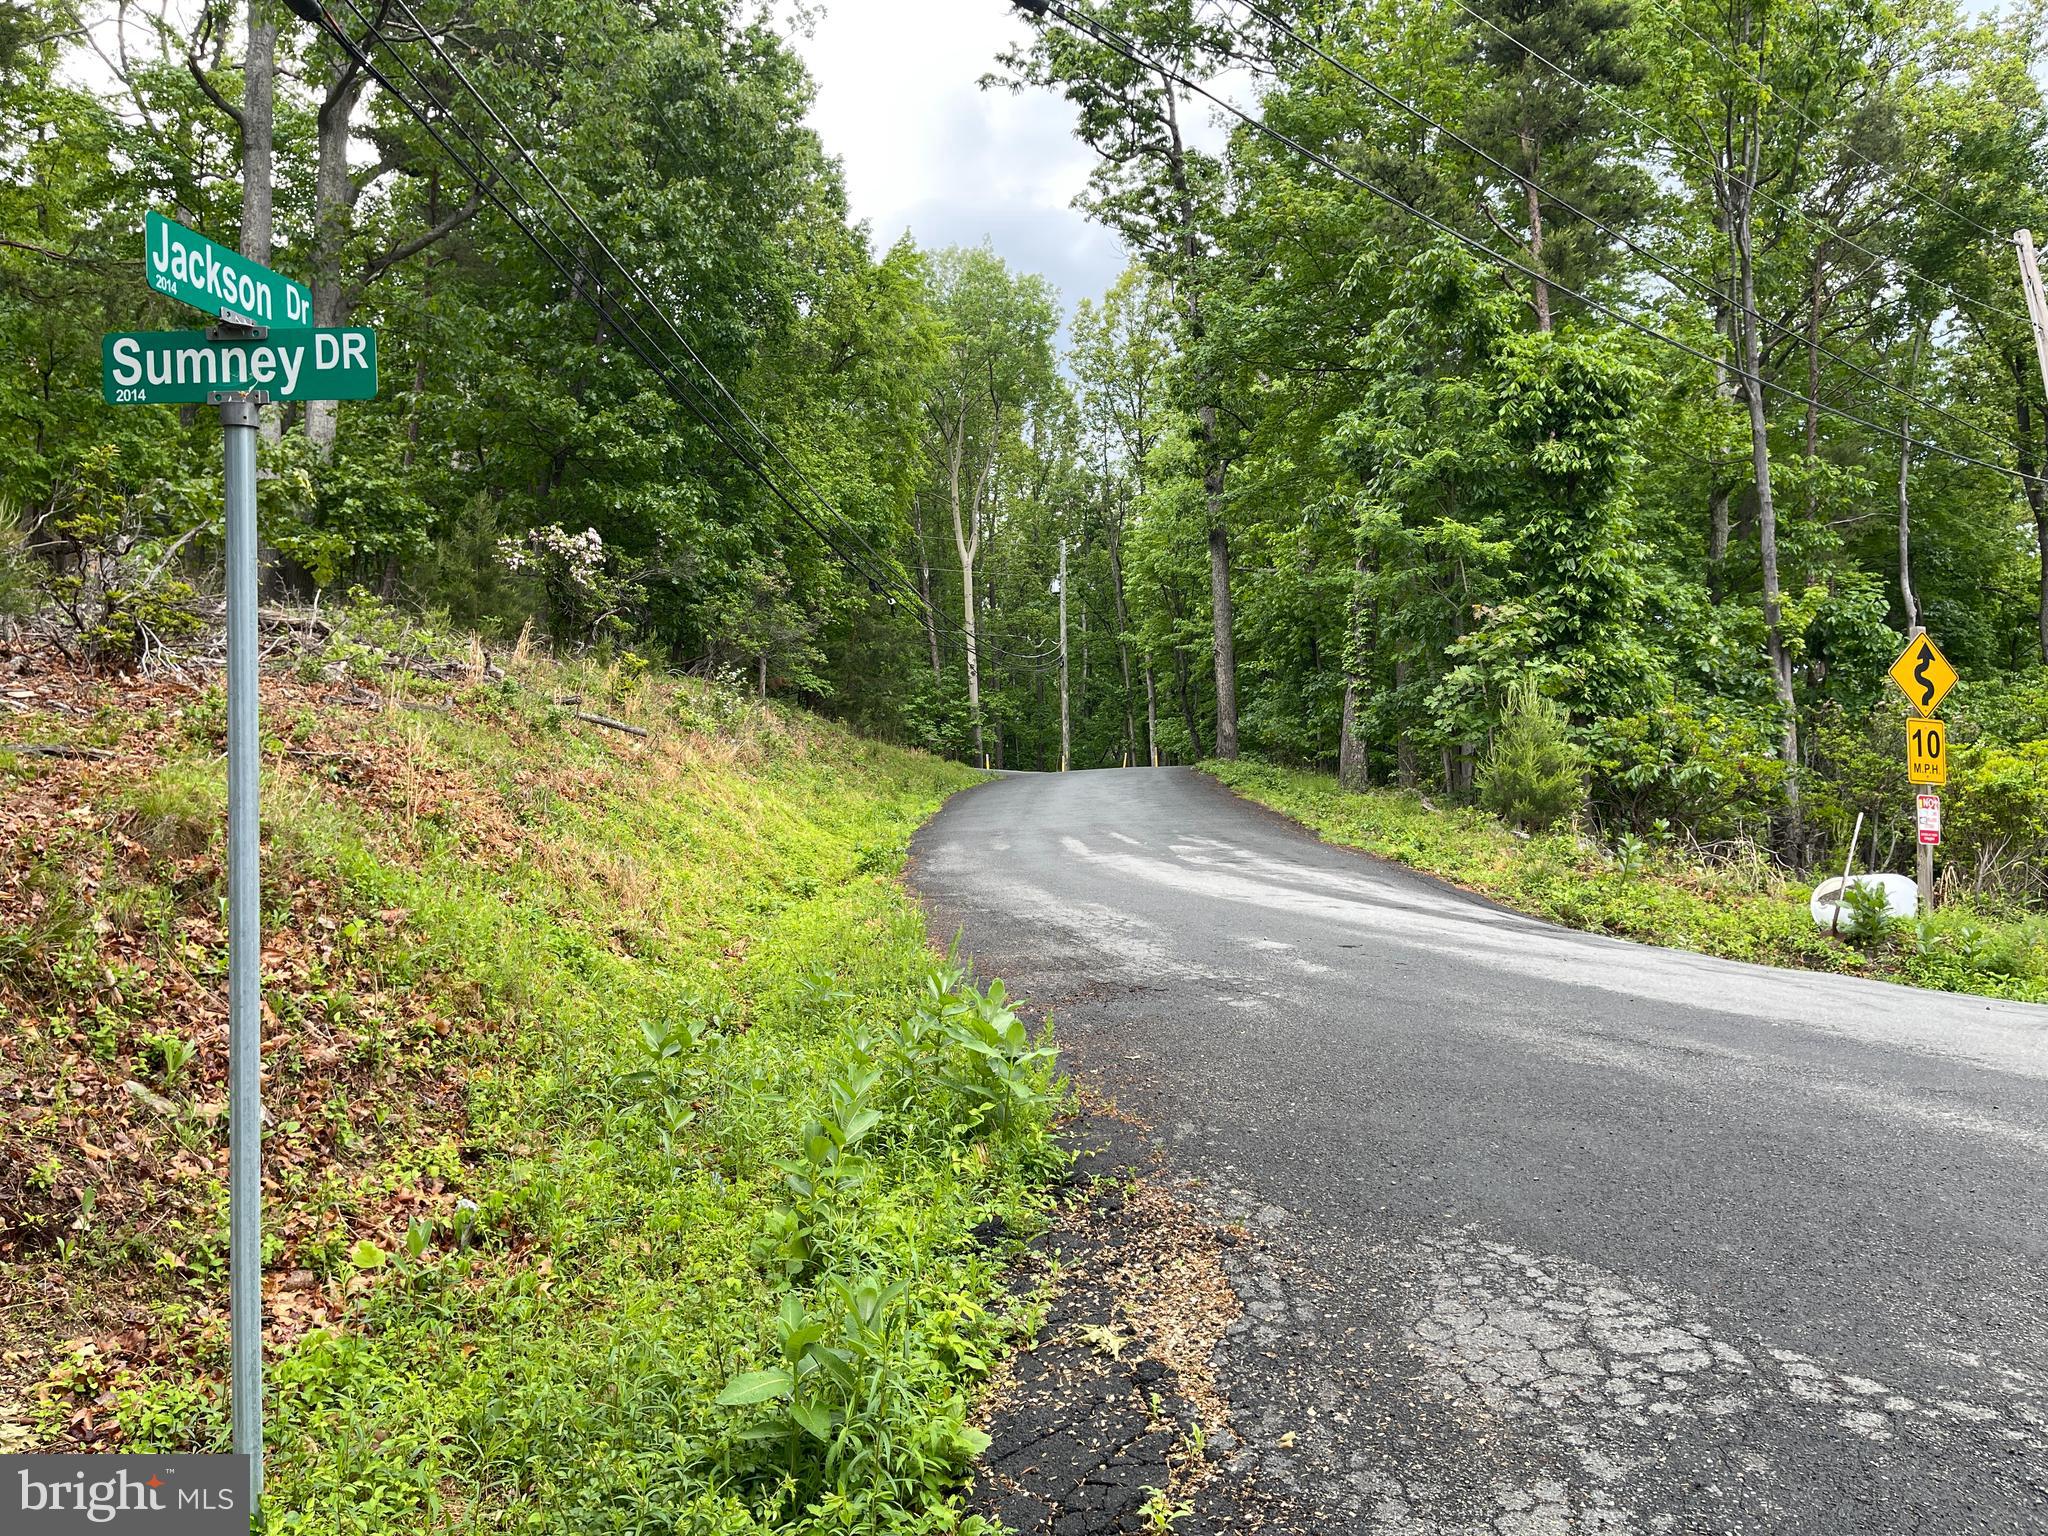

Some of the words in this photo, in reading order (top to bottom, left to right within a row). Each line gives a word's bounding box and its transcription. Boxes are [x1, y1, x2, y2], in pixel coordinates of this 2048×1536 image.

[152, 222, 272, 320] Jackson
[286, 285, 310, 325] Dr
[155, 274, 177, 296] 2014
[112, 338, 305, 396] Sumney
[315, 333, 369, 370] DR
[115, 389, 146, 402] 2014
[1912, 728, 1941, 759] 10
